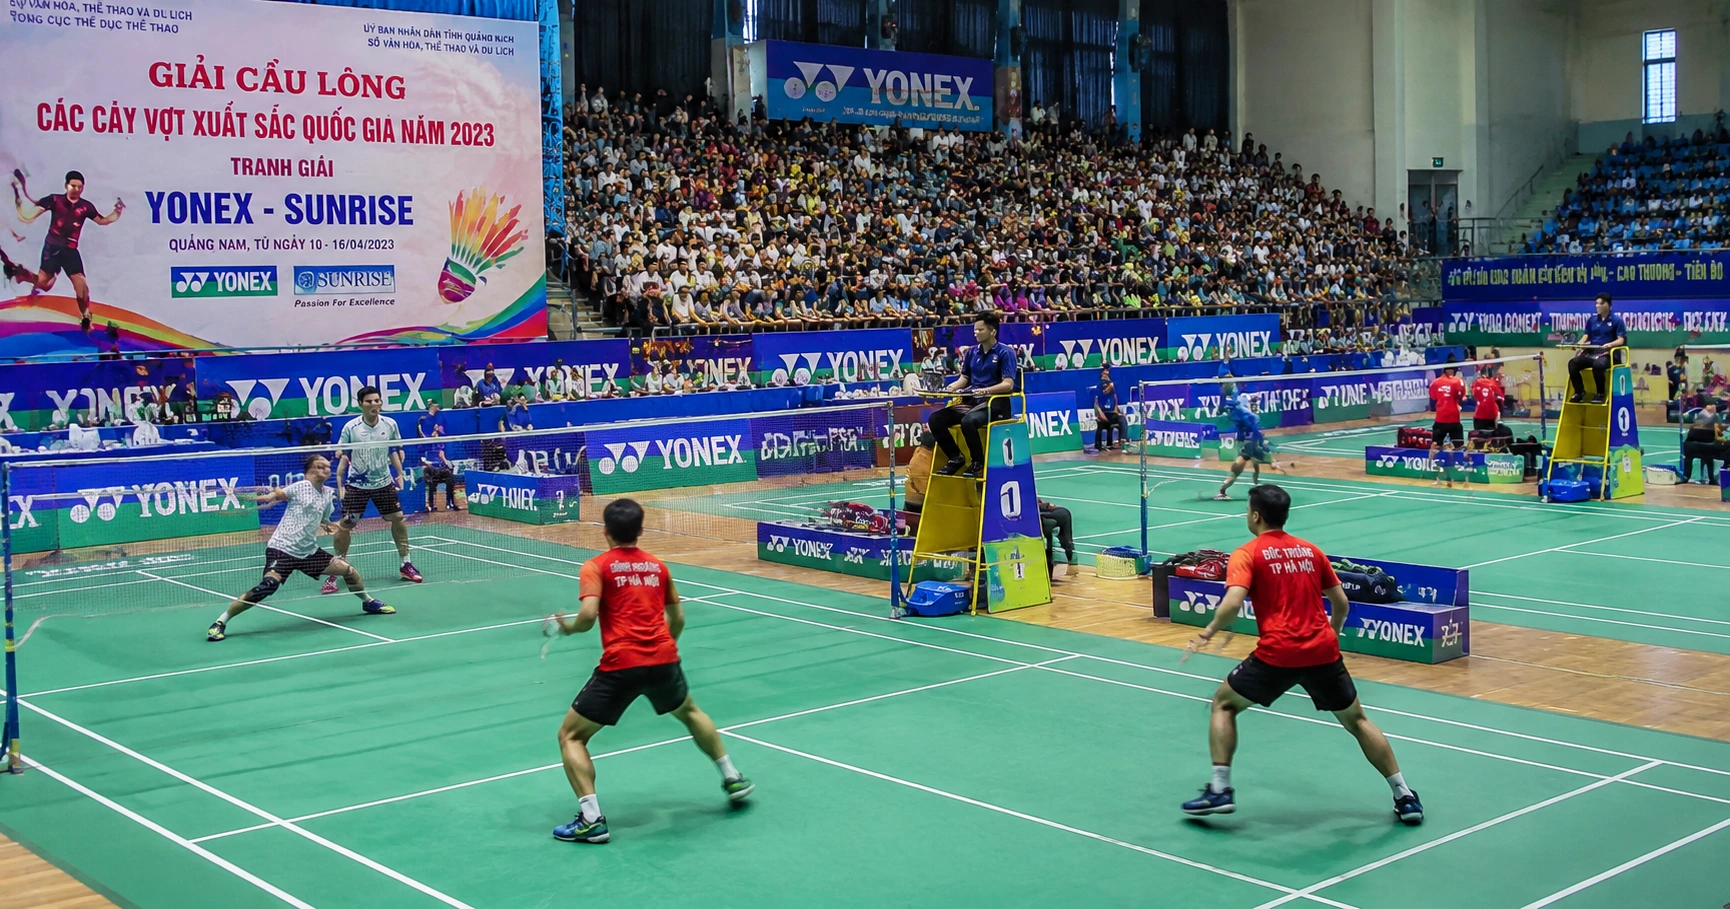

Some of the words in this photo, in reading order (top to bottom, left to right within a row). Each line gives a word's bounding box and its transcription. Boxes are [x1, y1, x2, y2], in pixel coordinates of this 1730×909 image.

[106, 5, 134, 16] THAO
[150, 23, 178, 33] THAO
[378, 26, 394, 34] BAN
[444, 44, 466, 52] THAO
[482, 46, 493, 54] DU
[149, 54, 225, 90] GIẢI
[236, 59, 306, 94] CẦU
[318, 67, 406, 99] LÔNG
[863, 68, 977, 110] YONEX
[37, 98, 84, 132] CÁC
[144, 107, 185, 141] VỢT
[193, 101, 247, 138] XUẤT
[254, 104, 296, 139] SẮC
[303, 106, 356, 144] QUỐC
[402, 114, 445, 144] NĂM
[450, 122, 495, 146] 2023
[230, 157, 292, 176] TRANH
[145, 192, 254, 224] YONEX
[263, 206, 274, 214] -
[284, 193, 414, 225] SUNRISE
[219, 239, 250, 252] NAM,
[310, 239, 322, 250] 10
[332, 239, 394, 250] 16/04/2023
[214, 271, 272, 292] YONEX
[318, 271, 392, 287] SUNRISE
[294, 300, 330, 308] Passion
[350, 298, 395, 306] Excellence
[1098, 337, 1160, 366] YONEX
[1216, 331, 1272, 359] YONEX
[826, 349, 904, 383] YONEX
[655, 434, 743, 470] YONEX
[132, 477, 240, 517] YONEX
[1269, 563, 1282, 574] TP
